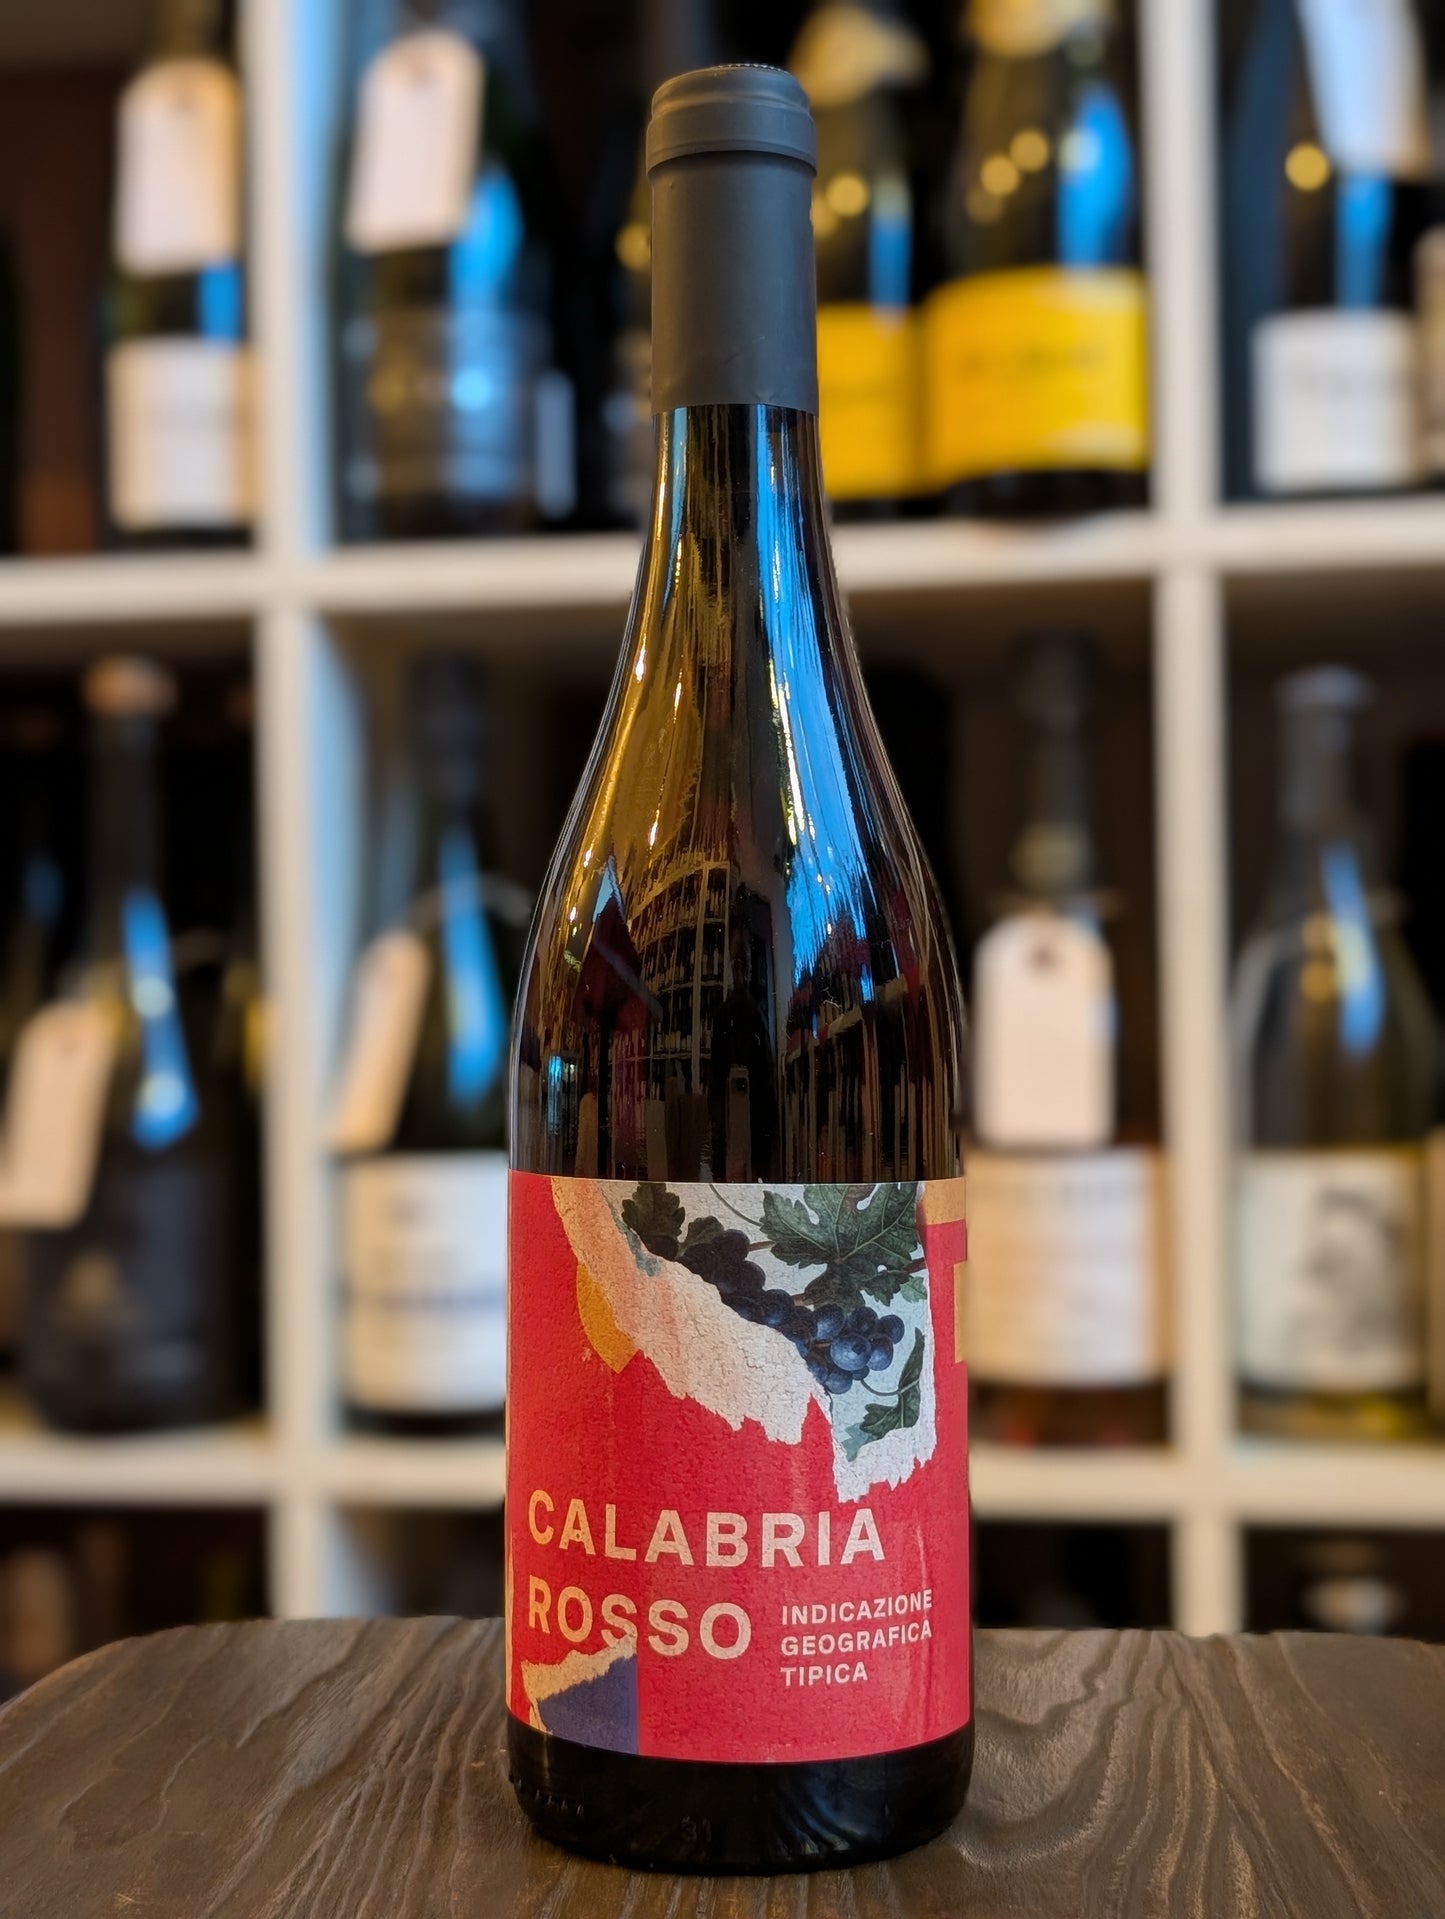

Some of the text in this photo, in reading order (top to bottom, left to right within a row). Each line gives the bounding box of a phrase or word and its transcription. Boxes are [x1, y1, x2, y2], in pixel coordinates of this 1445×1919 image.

[528, 1489, 885, 1568] CALABRIA
[528, 1574, 752, 1660] ROSSO
[782, 1589, 932, 1626] INDICAZIONE
[781, 1619, 932, 1657] GEOGRAFICA
[780, 1661, 868, 1687] TIPICA
